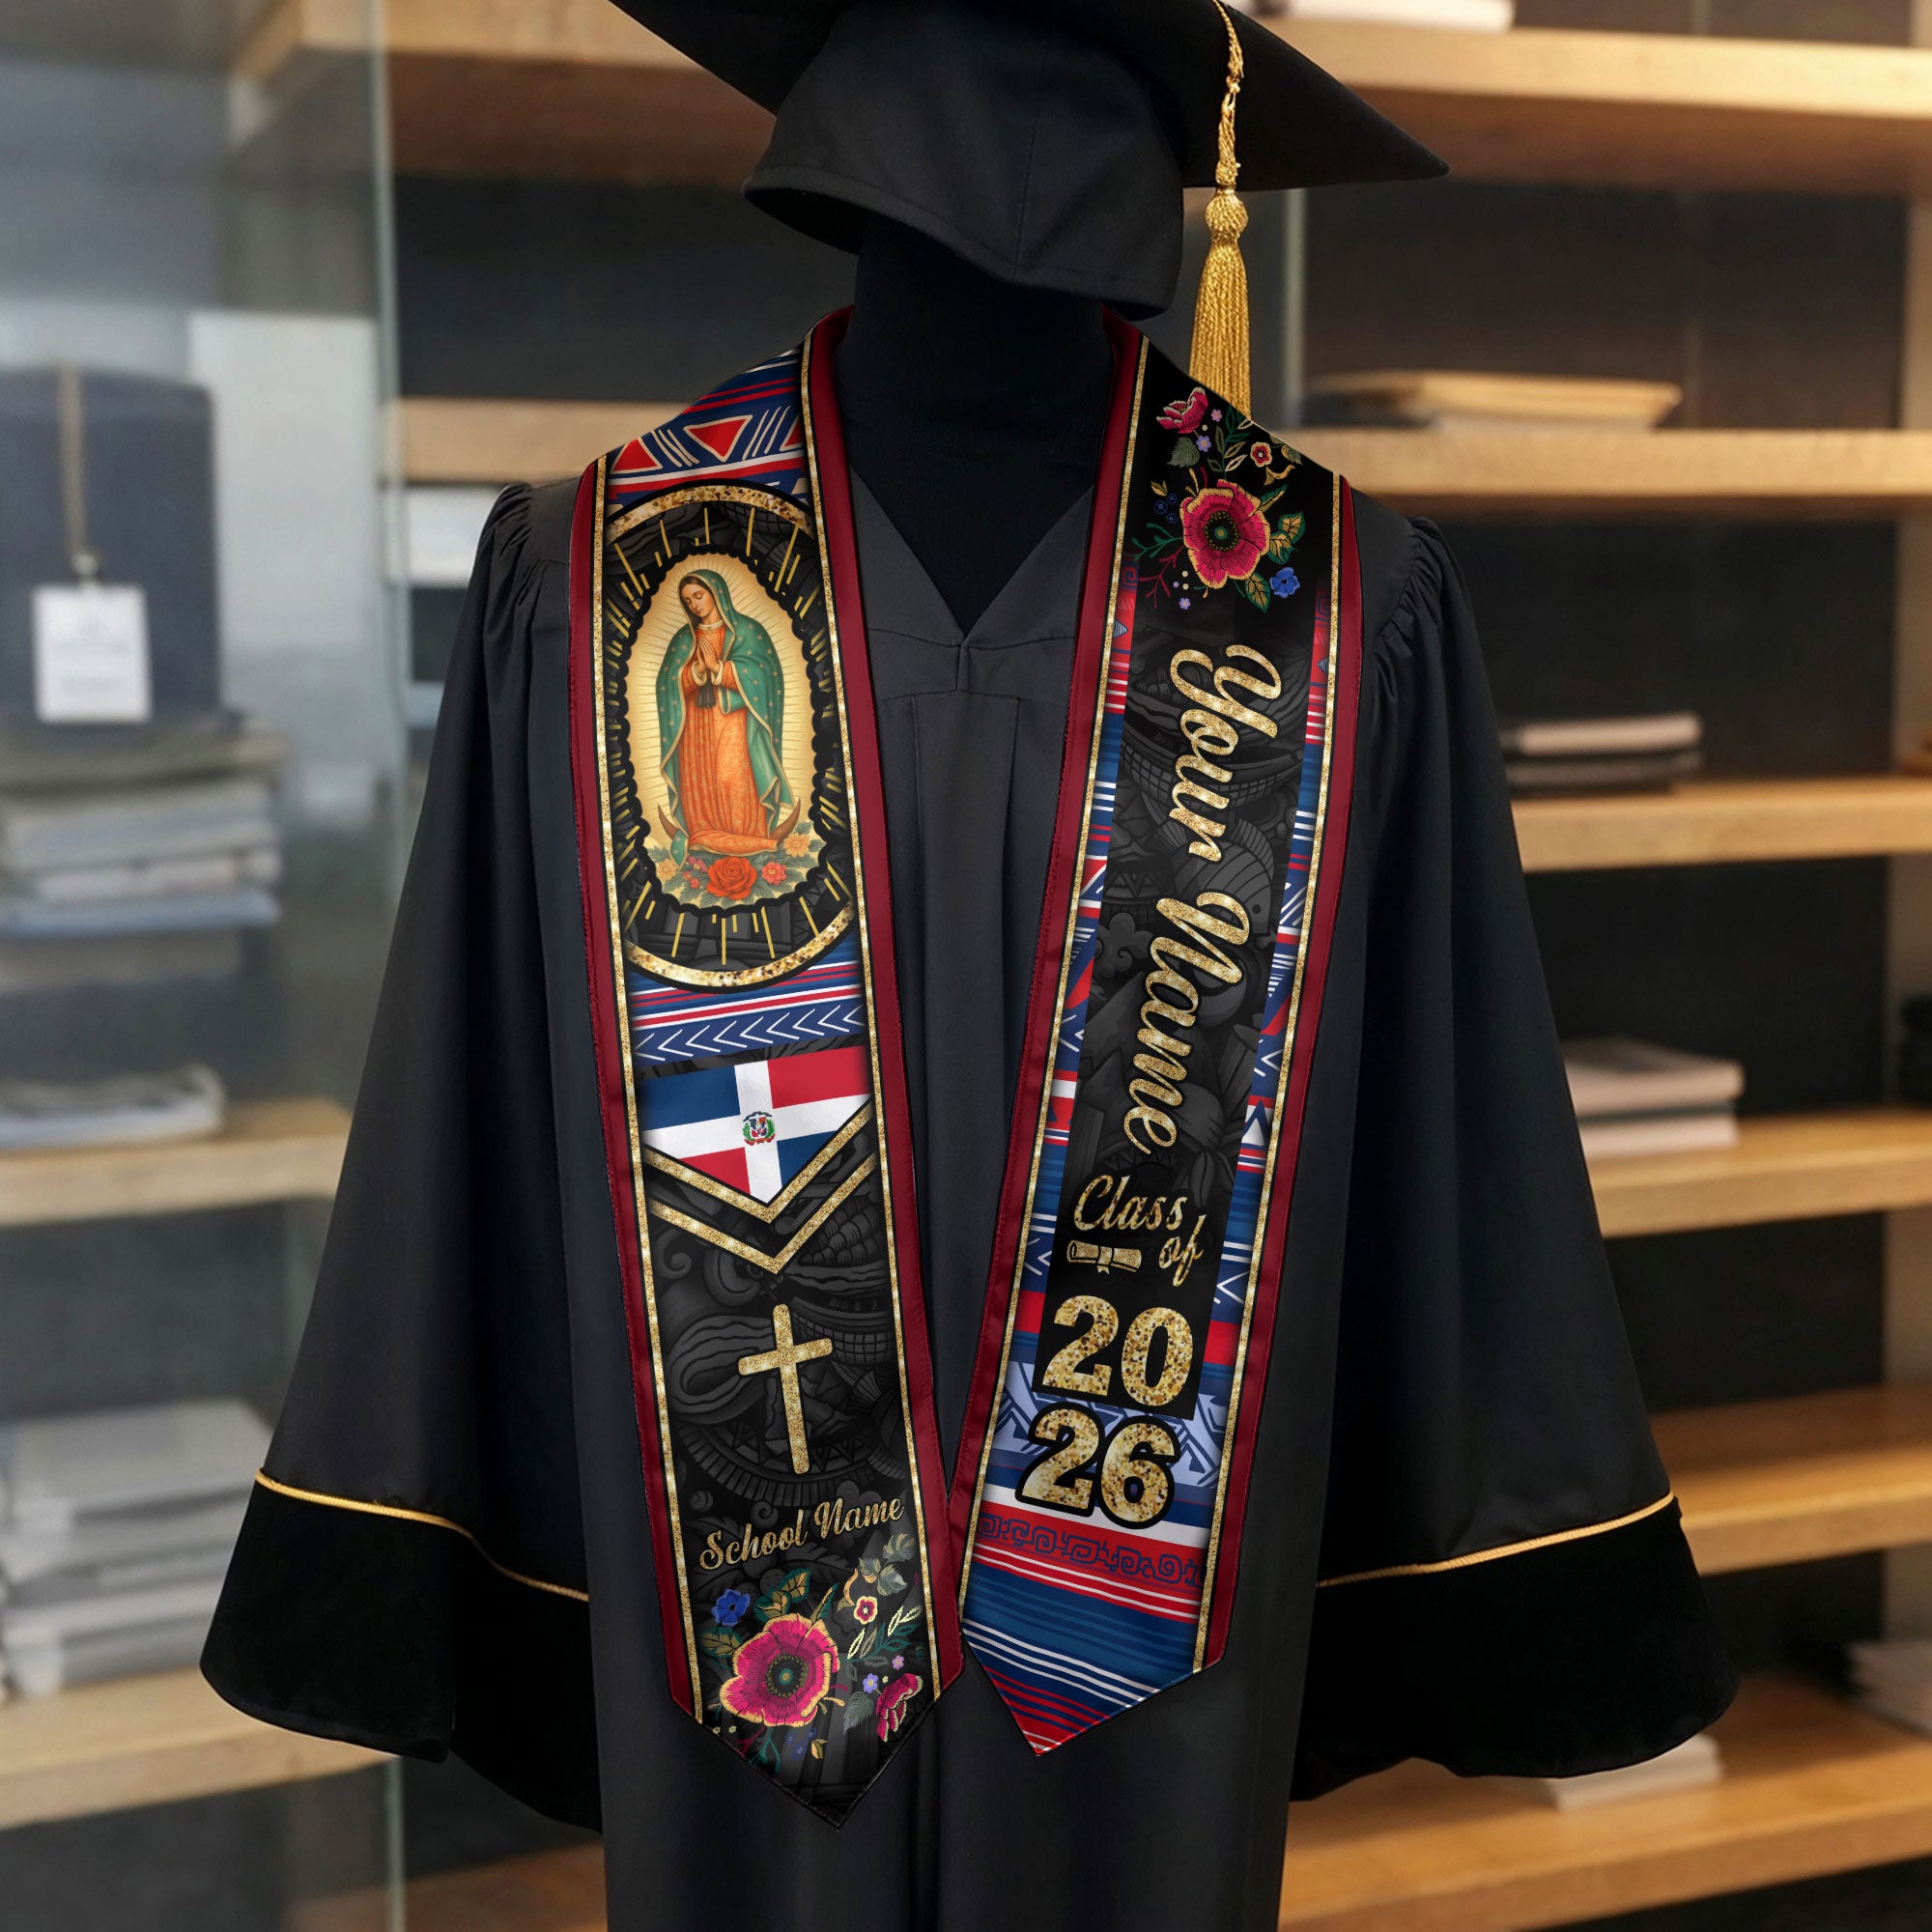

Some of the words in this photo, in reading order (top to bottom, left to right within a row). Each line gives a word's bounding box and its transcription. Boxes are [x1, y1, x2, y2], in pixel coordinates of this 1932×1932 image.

[1169, 644, 1282, 863] Your
[1122, 891, 1250, 1154] Name
[1073, 1173, 1188, 1232] Class
[1158, 1214, 1206, 1288] of
[1041, 1294, 1194, 1406] 20
[1021, 1407, 1177, 1522] 26
[698, 1509, 808, 1571] School
[813, 1497, 905, 1539] Name
